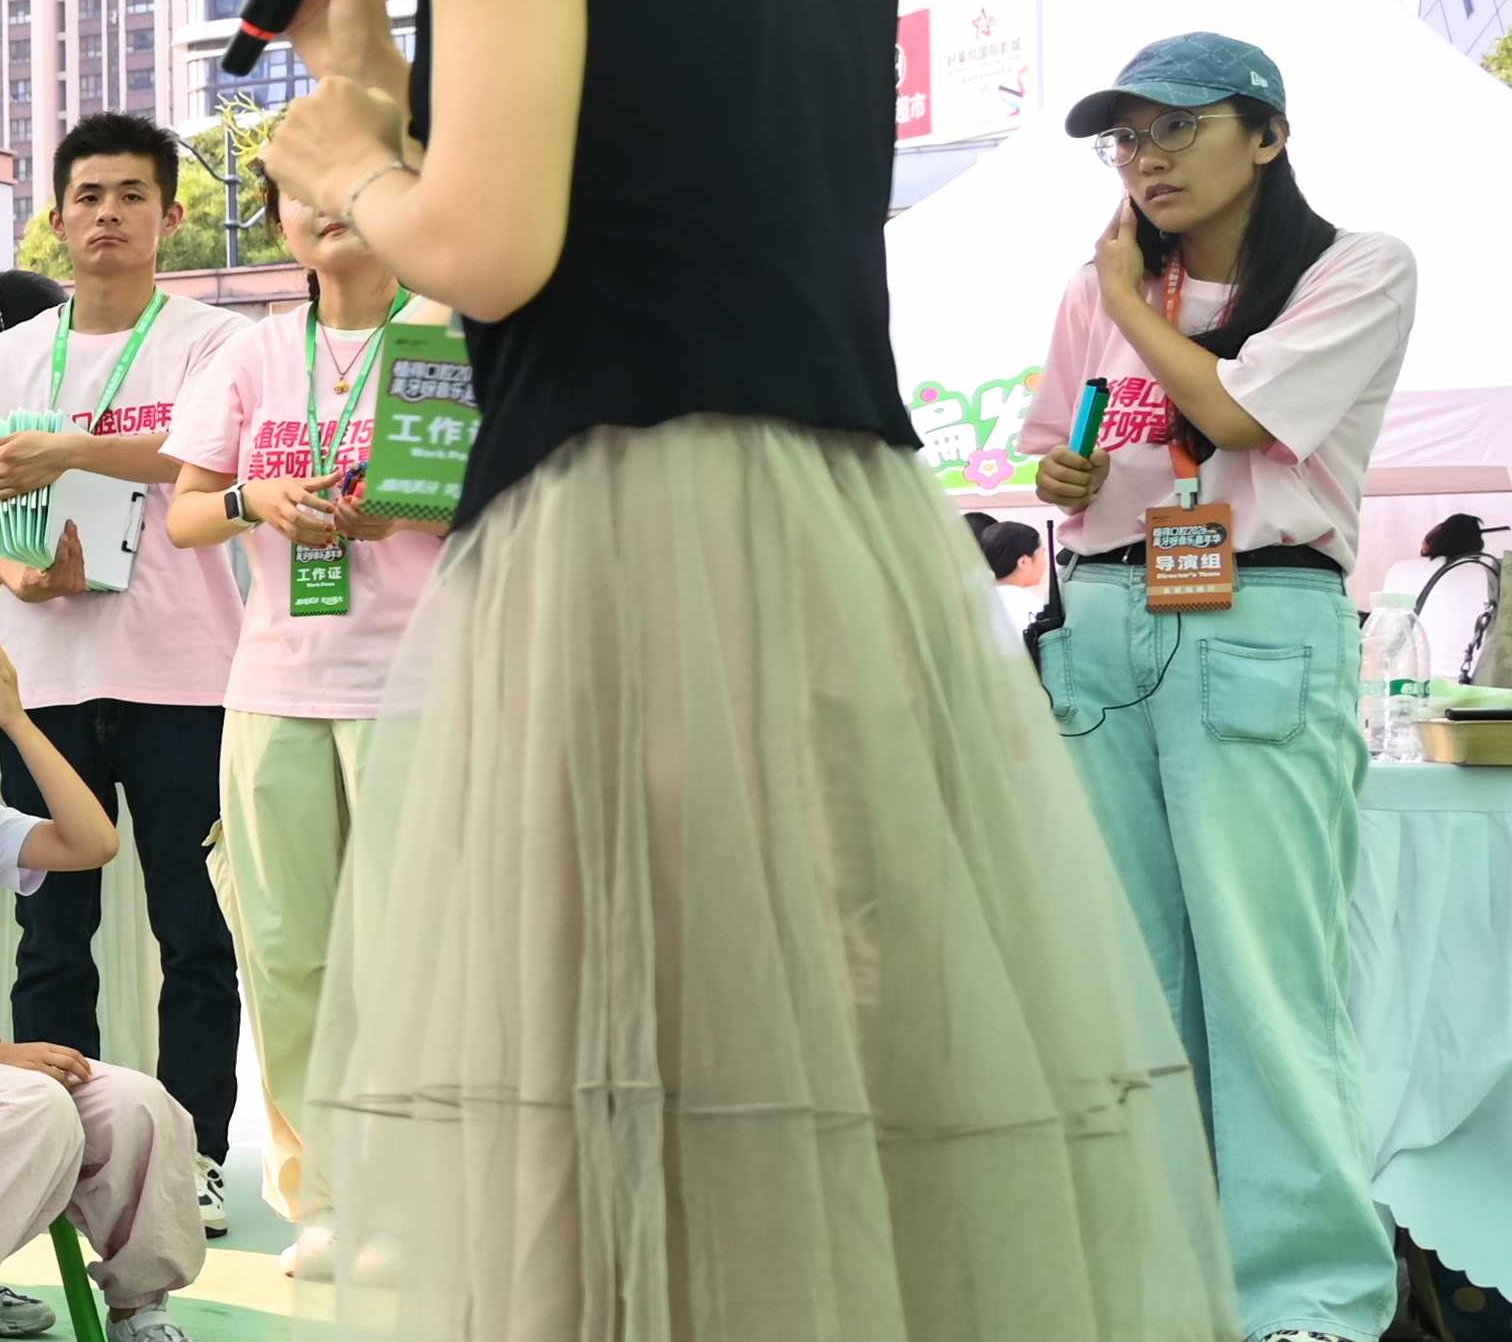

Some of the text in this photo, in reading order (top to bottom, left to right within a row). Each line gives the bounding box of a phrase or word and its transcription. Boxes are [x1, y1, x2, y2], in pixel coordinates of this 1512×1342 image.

[1155, 553, 1221, 571] 导演组
[296, 566, 343, 582] 工作证
